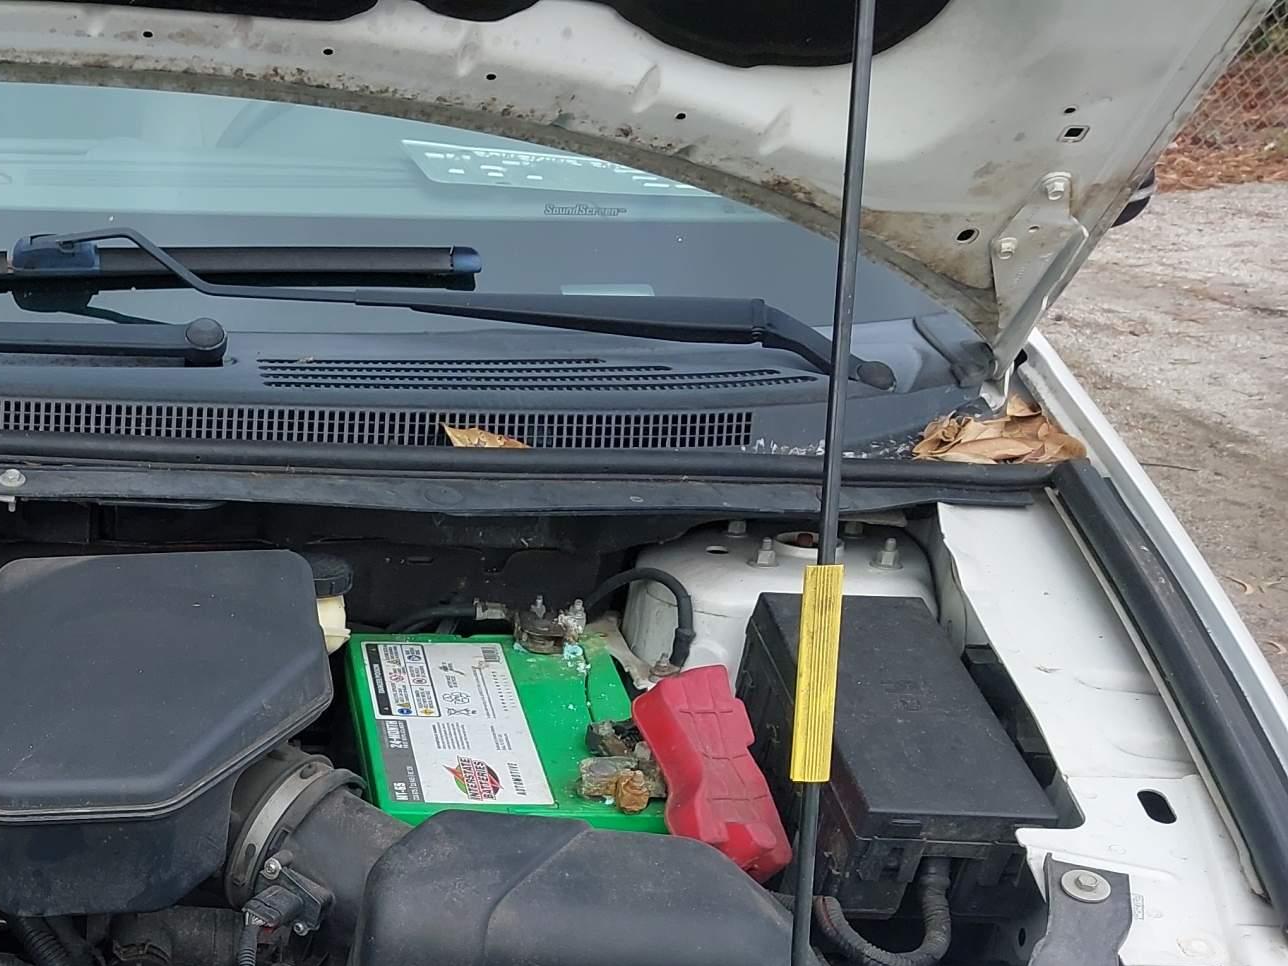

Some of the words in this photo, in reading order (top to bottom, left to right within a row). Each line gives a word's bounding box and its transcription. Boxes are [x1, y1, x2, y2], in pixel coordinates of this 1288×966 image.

[459, 756, 482, 800] INTERSTATE
[474, 760, 496, 799] BATTERIES
[507, 762, 527, 796] AUTOMOTIVE
